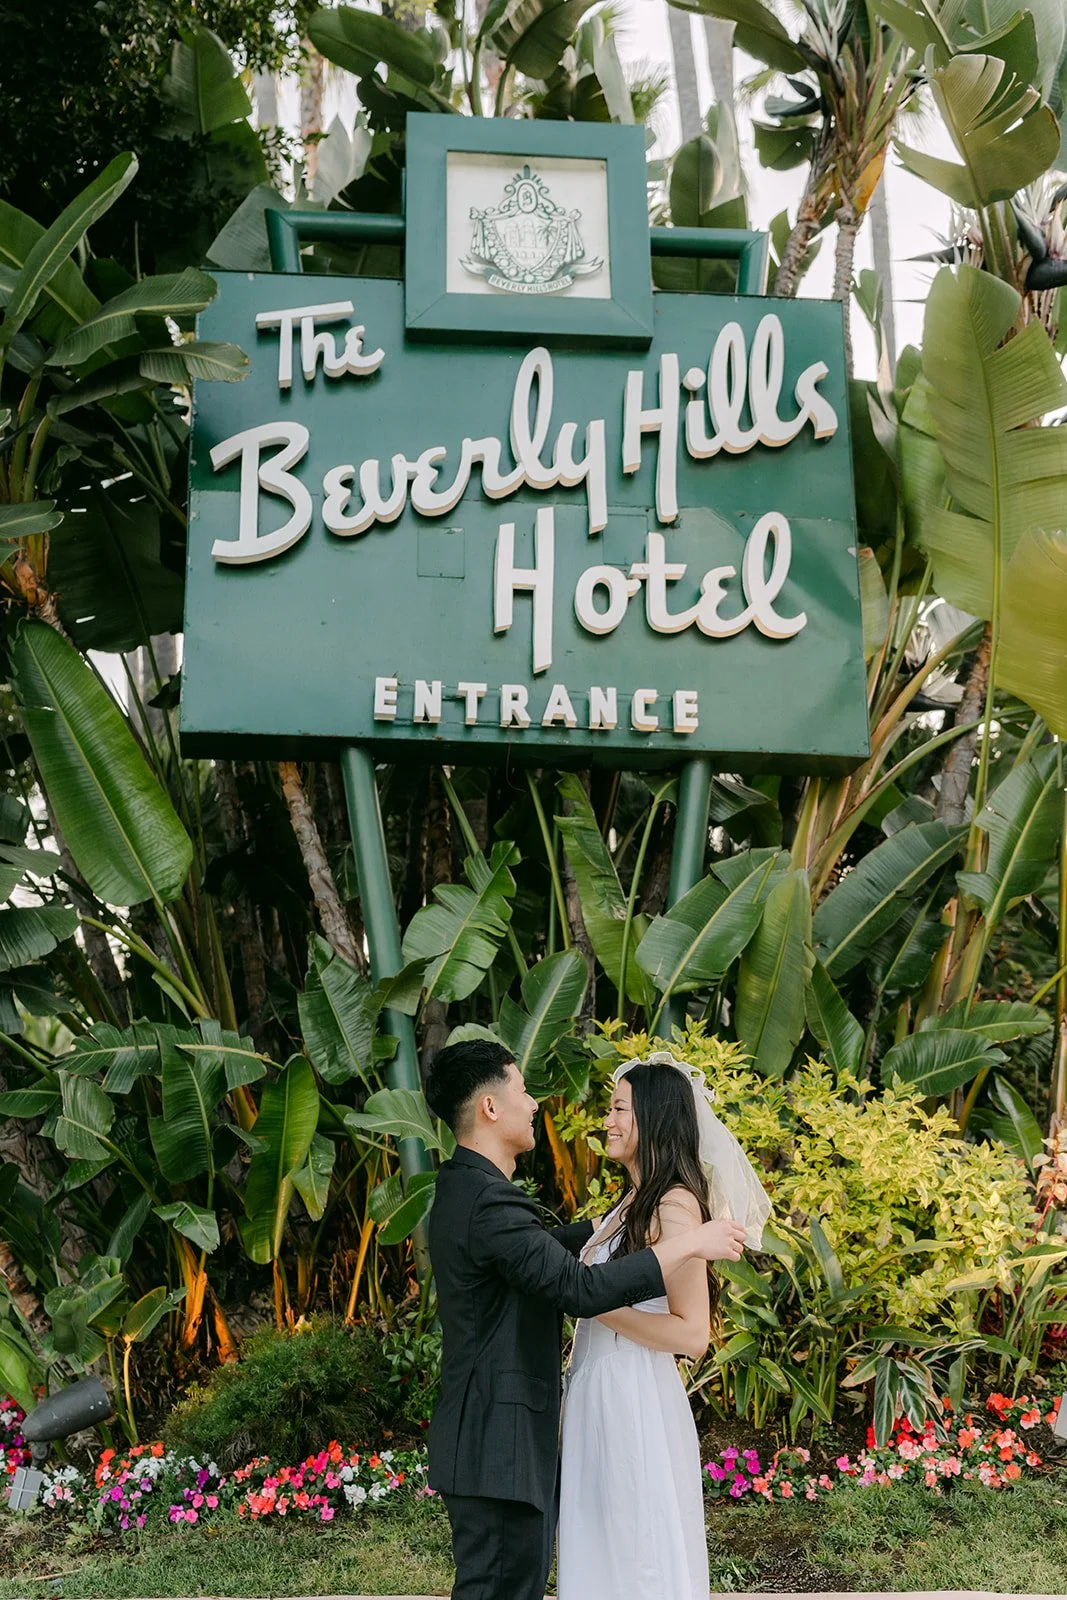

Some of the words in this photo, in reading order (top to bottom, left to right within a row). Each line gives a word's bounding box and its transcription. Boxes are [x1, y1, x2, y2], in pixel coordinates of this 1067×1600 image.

[490, 274, 527, 291] BEVERLY
[527, 283, 548, 292] HILLS
[548, 278, 570, 290] HOTEL
[255, 300, 386, 388] The
[209, 346, 608, 564] Beverly
[623, 313, 839, 523] Hills
[494, 507, 808, 674] Hotel
[373, 676, 699, 733] ENTRANCE
